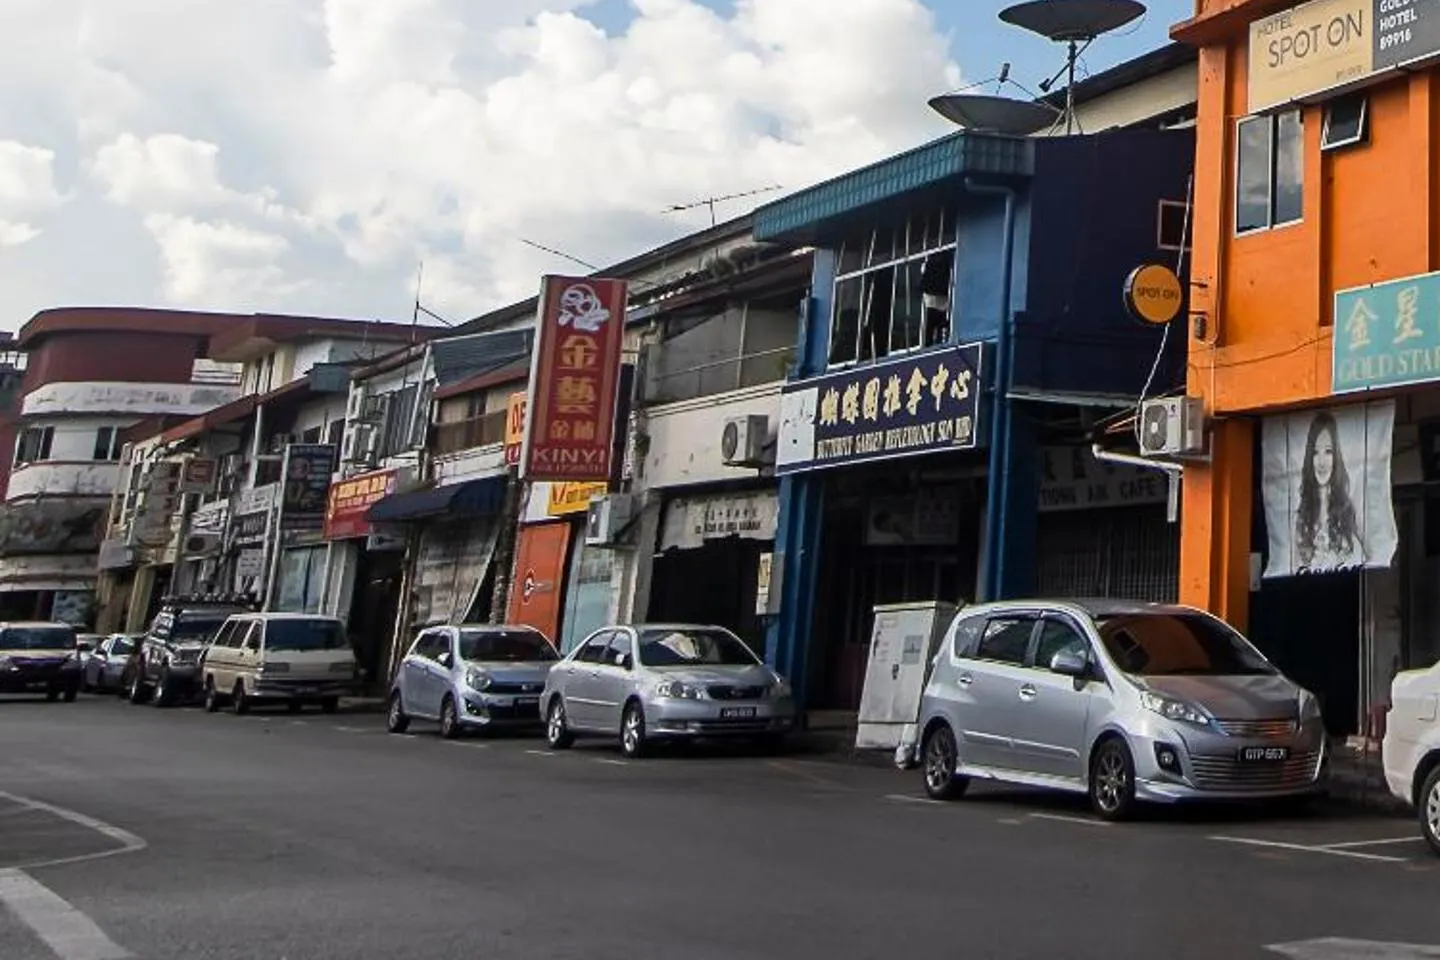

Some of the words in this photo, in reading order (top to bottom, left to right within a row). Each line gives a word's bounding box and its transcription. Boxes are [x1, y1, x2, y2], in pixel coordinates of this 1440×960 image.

[1257, 14, 1293, 38] HOTEL
[1380, 8, 1417, 32] HOTEL
[1268, 24, 1321, 68] SPOT
[1327, 10, 1363, 46] ON
[1338, 353, 1393, 383] GOLD
[532, 447, 606, 463] KINYI
